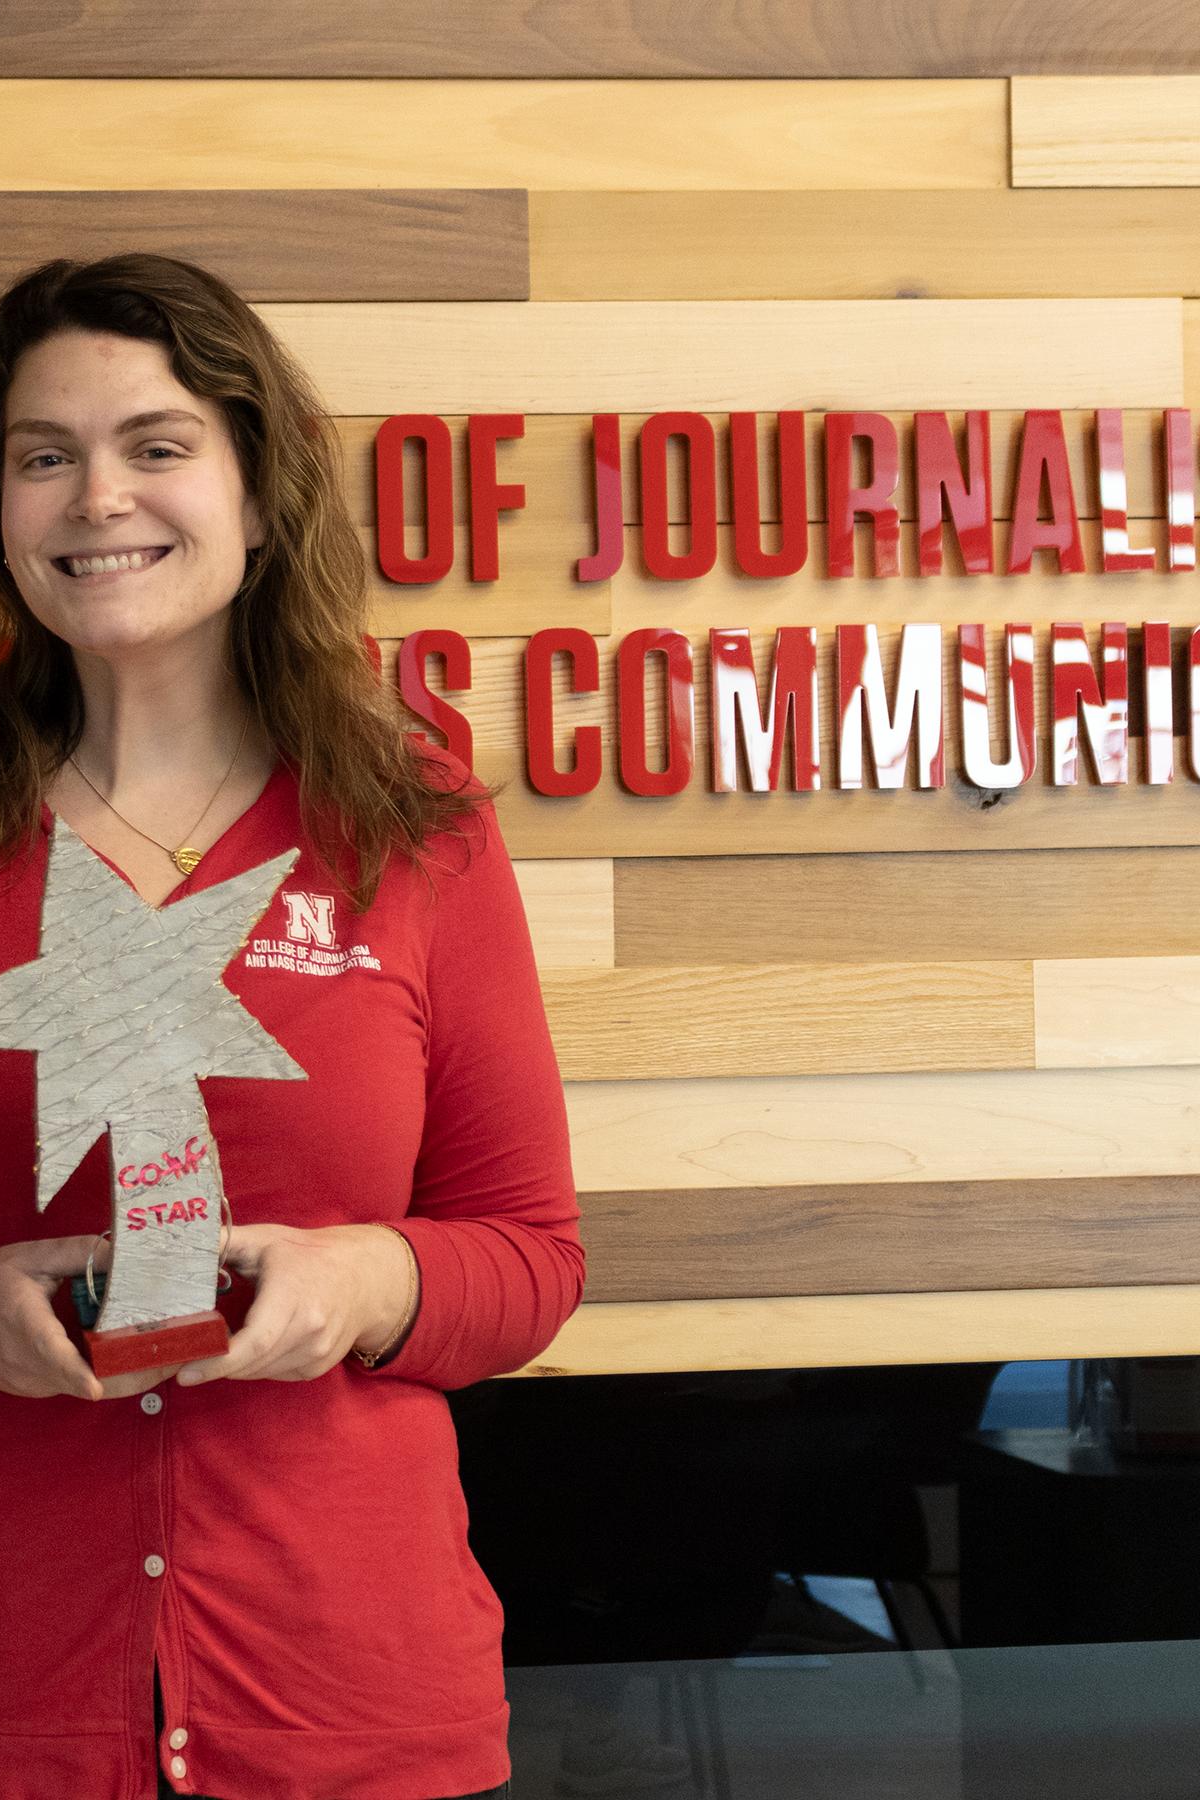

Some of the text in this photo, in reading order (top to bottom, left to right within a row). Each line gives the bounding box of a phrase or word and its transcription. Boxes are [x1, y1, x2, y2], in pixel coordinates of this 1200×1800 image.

[376, 413, 526, 584] OF
[526, 620, 1200, 798] COMMUNI
[281, 891, 336, 949] N
[245, 953, 382, 977] AND MASS COMMUNICATIONS
[253, 939, 371, 965] COLLEGE OF JOURNALISM
[126, 1197, 209, 1231] STAR
